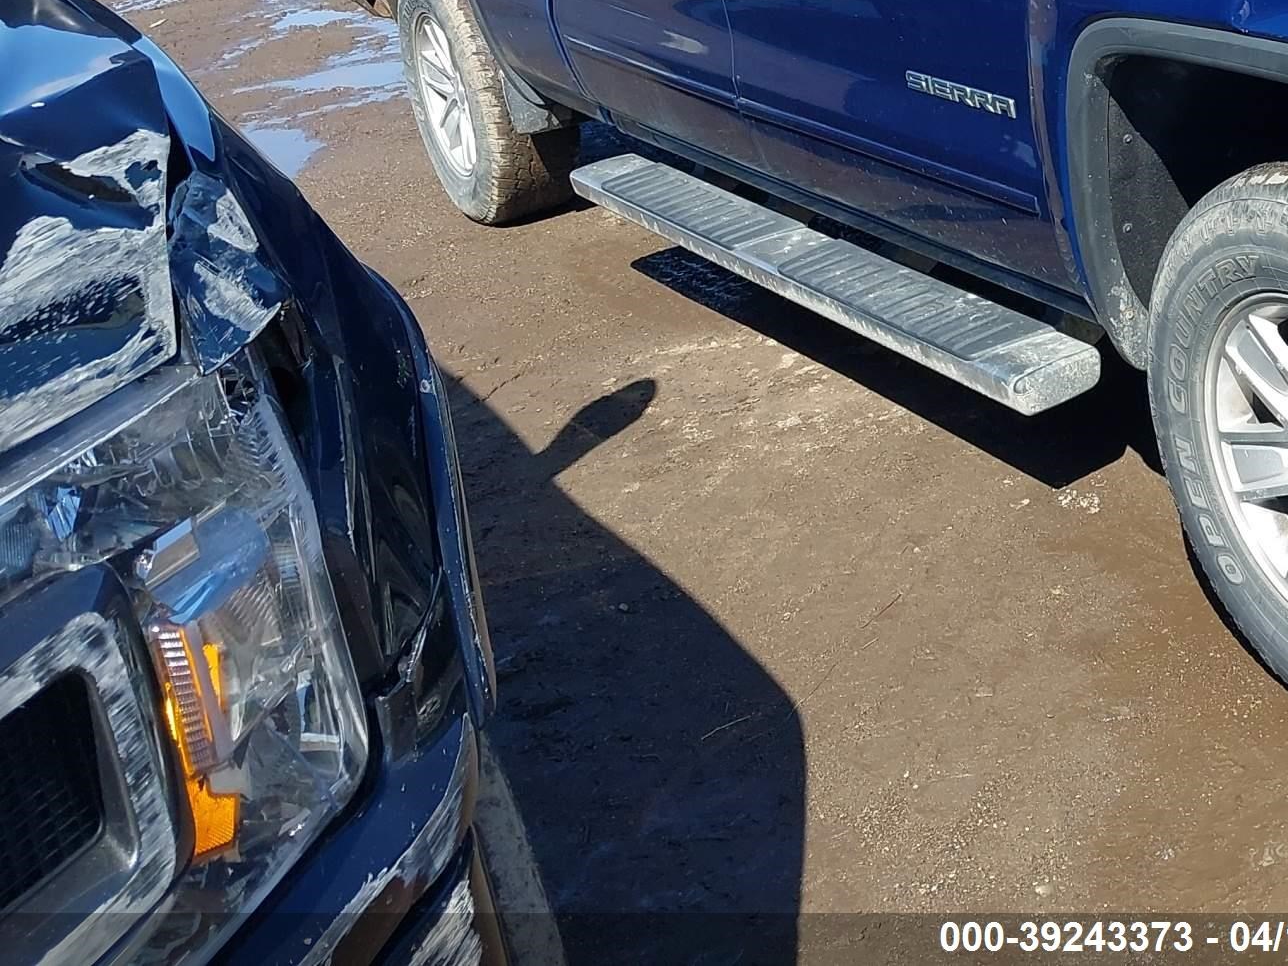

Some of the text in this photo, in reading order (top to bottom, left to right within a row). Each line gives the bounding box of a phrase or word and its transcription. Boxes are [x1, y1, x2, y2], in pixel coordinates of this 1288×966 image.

[905, 69, 1017, 120] SIERRA
[1167, 254, 1261, 586] OPEN COUNTRY
